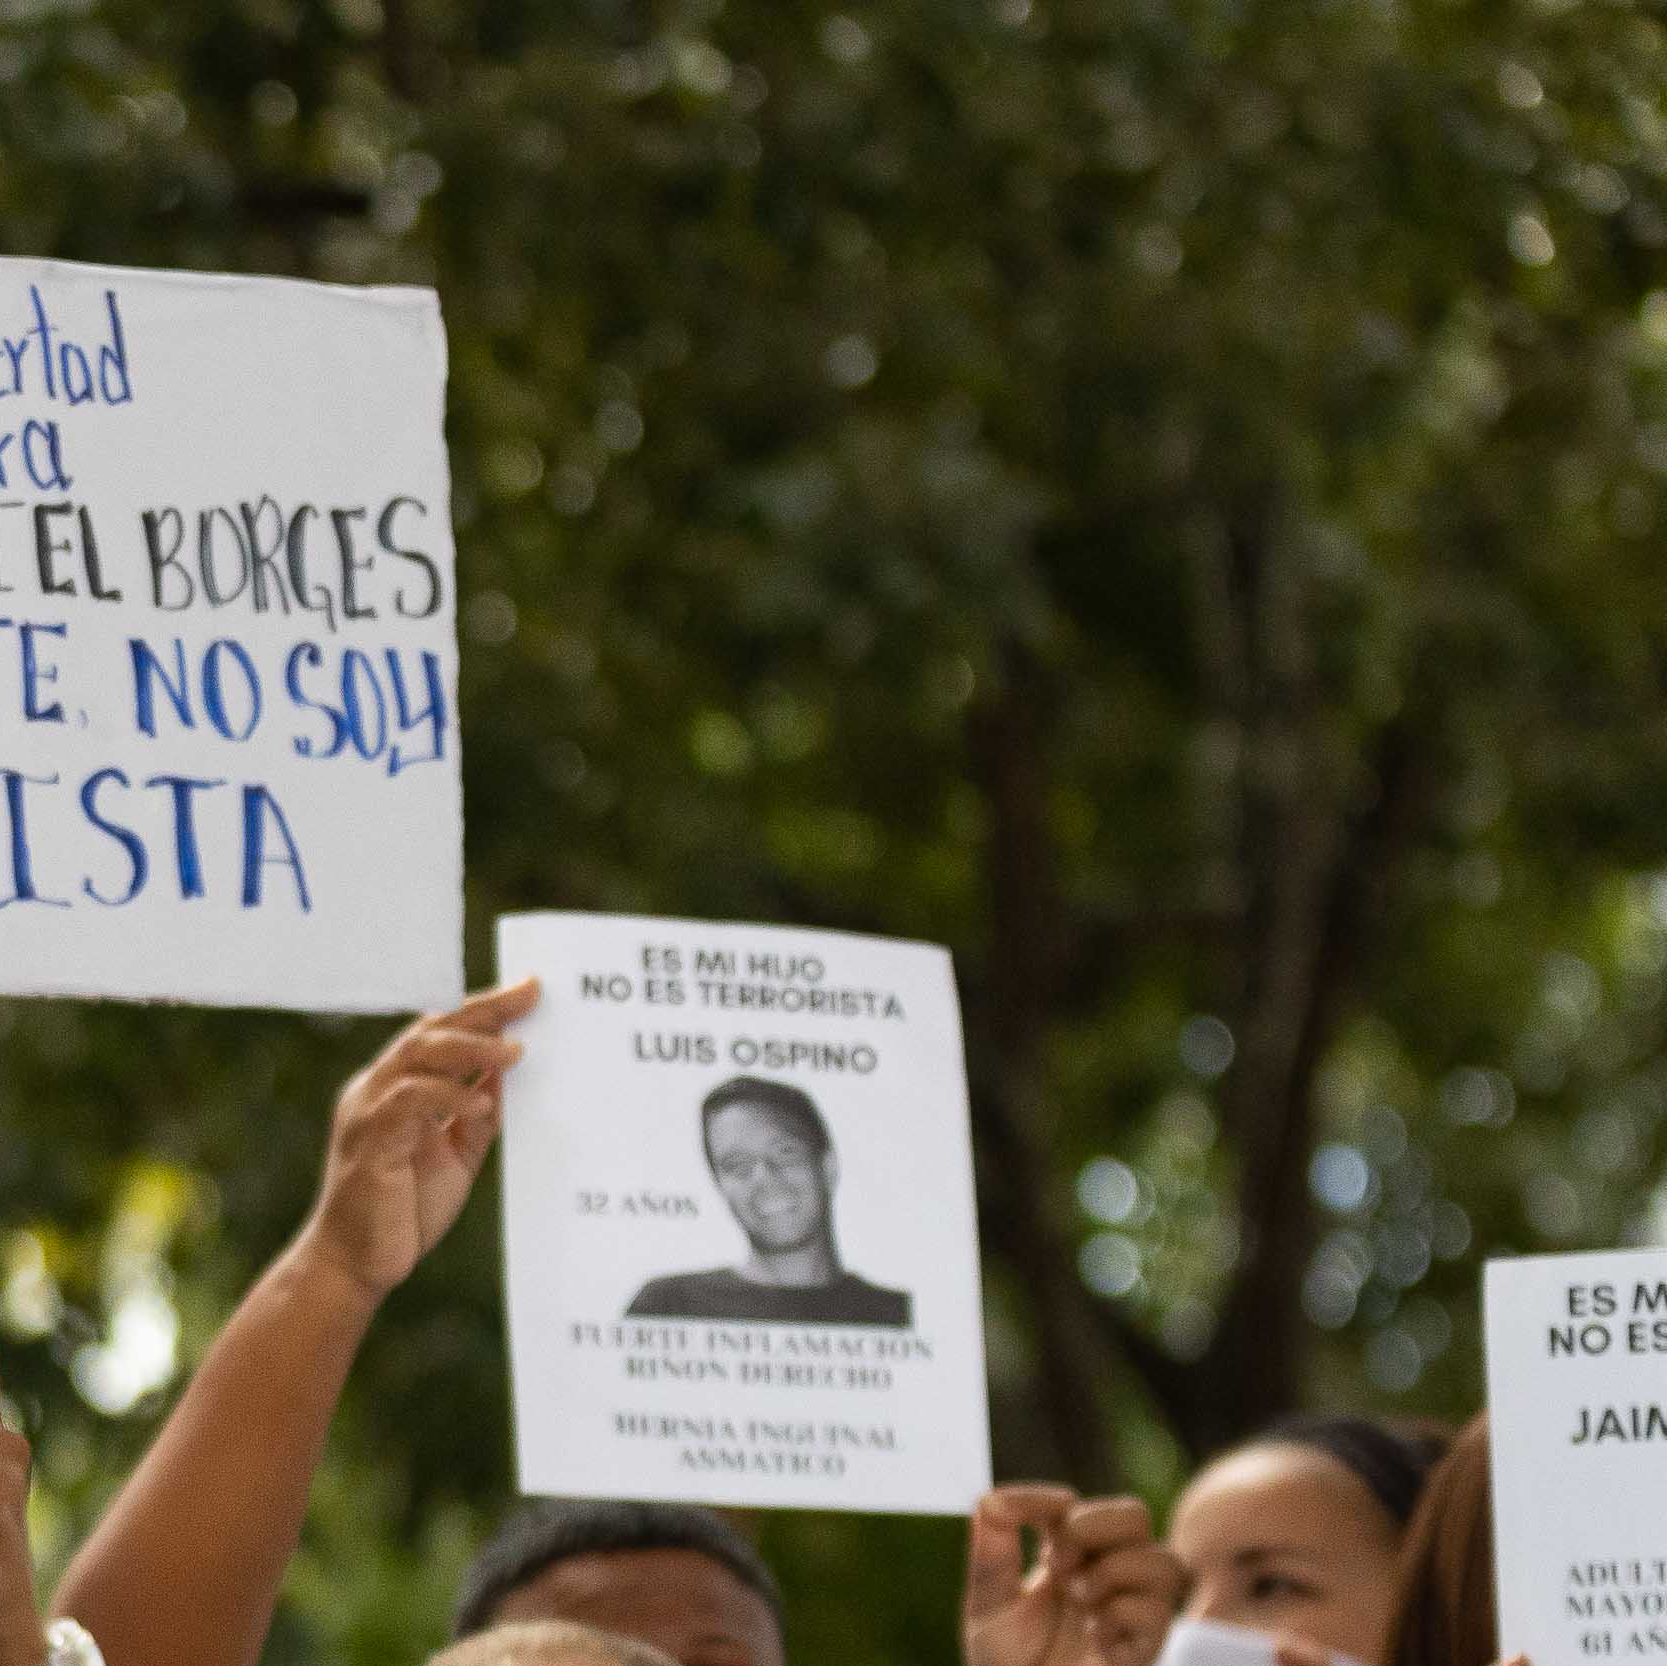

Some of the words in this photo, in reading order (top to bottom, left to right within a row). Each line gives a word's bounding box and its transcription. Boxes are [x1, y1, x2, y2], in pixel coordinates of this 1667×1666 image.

[143, 495, 442, 631] BORGES
[131, 637, 259, 739] NO
[285, 643, 446, 776] SOY
[641, 945, 683, 975] ES
[695, 948, 736, 977] MI
[747, 952, 827, 982] HIJO
[579, 973, 633, 1003] NO
[644, 977, 686, 1006] ES
[698, 980, 905, 1022] TERRORISTA
[632, 1031, 718, 1064] LUIS
[730, 1036, 879, 1076] OSPINO
[1568, 1284, 1617, 1319] ES
[570, 1322, 688, 1351] FUERTE
[1548, 1322, 1612, 1358] NO
[739, 1360, 893, 1389] DERECHO
[613, 1412, 738, 1441] HERNIA
